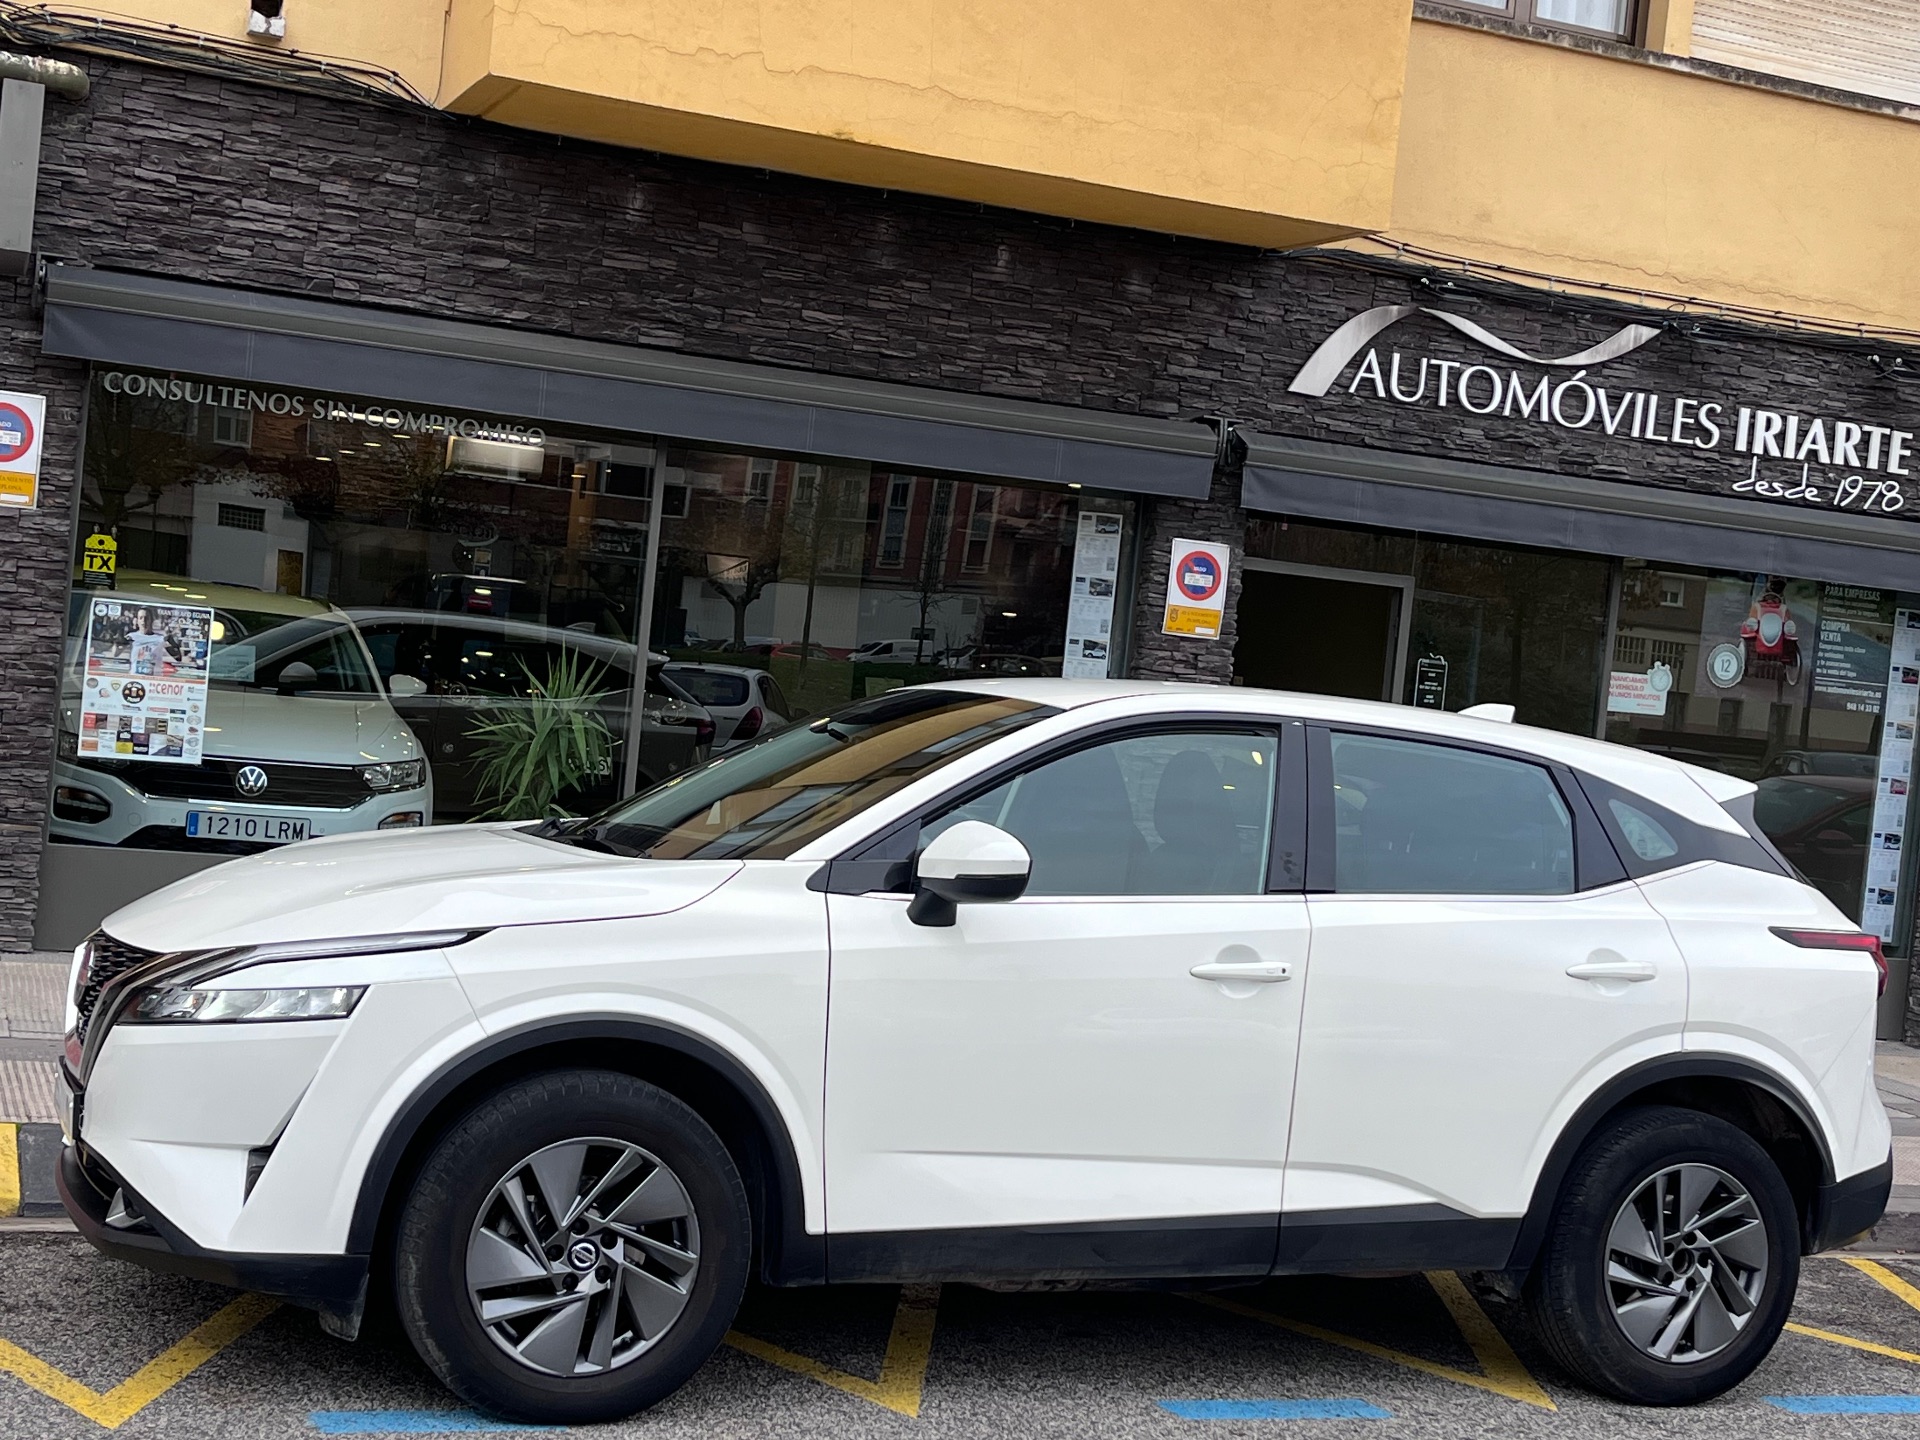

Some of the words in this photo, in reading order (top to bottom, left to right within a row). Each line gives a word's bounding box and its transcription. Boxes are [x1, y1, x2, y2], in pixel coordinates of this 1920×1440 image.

[103, 371, 307, 417] CONSULTENOS
[312, 398, 356, 424] SIN
[364, 406, 547, 448] COMPROMISO
[1348, 347, 1723, 449] AUTOMÓVILES
[1734, 407, 1914, 476] IRIARTE
[1731, 455, 1822, 502] desde
[1833, 475, 1905, 512] 1978
[86, 554, 113, 571] TX
[1821, 620, 1850, 632] COMPRA
[1820, 631, 1842, 643] VENTA
[1720, 658, 1732, 673] 12
[207, 815, 257, 837] 1210
[264, 819, 305, 841] LRM
